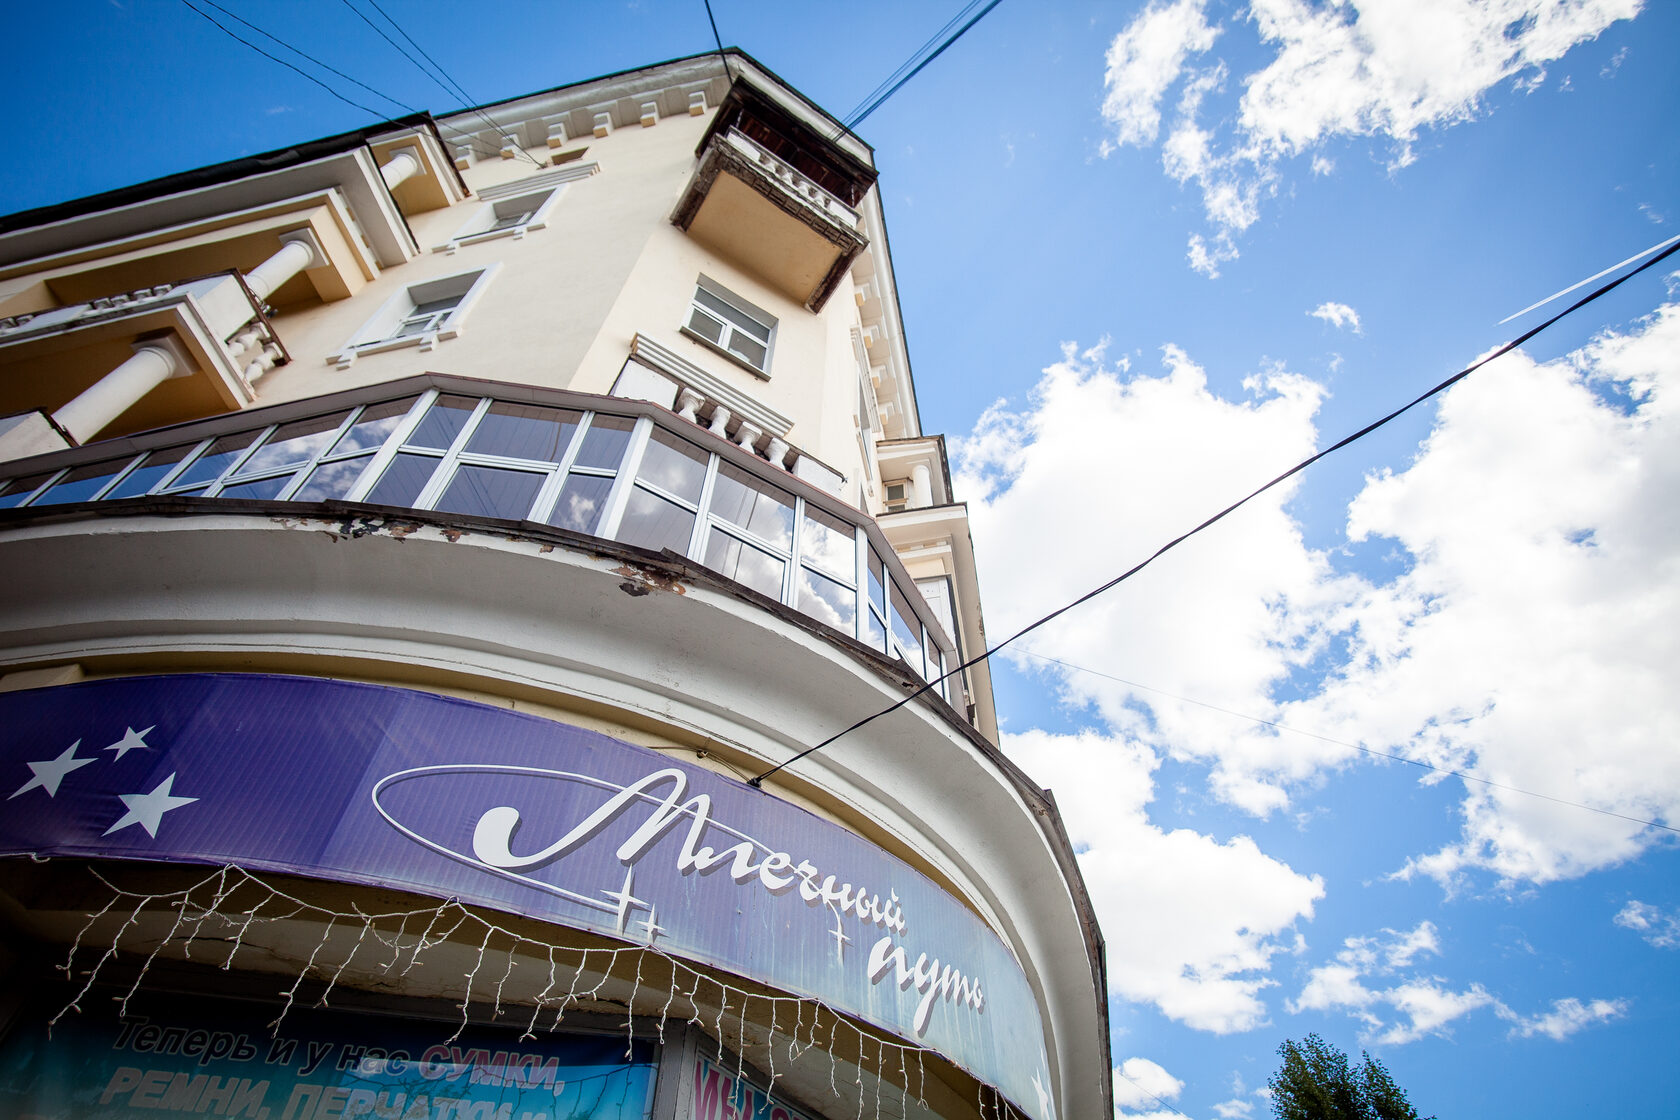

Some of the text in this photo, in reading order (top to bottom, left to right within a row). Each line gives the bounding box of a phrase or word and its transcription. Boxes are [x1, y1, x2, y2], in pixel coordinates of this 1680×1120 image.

[473, 768, 905, 932] Млечный
[113, 1015, 566, 1097] Теперь и у нас СУМКИ,
